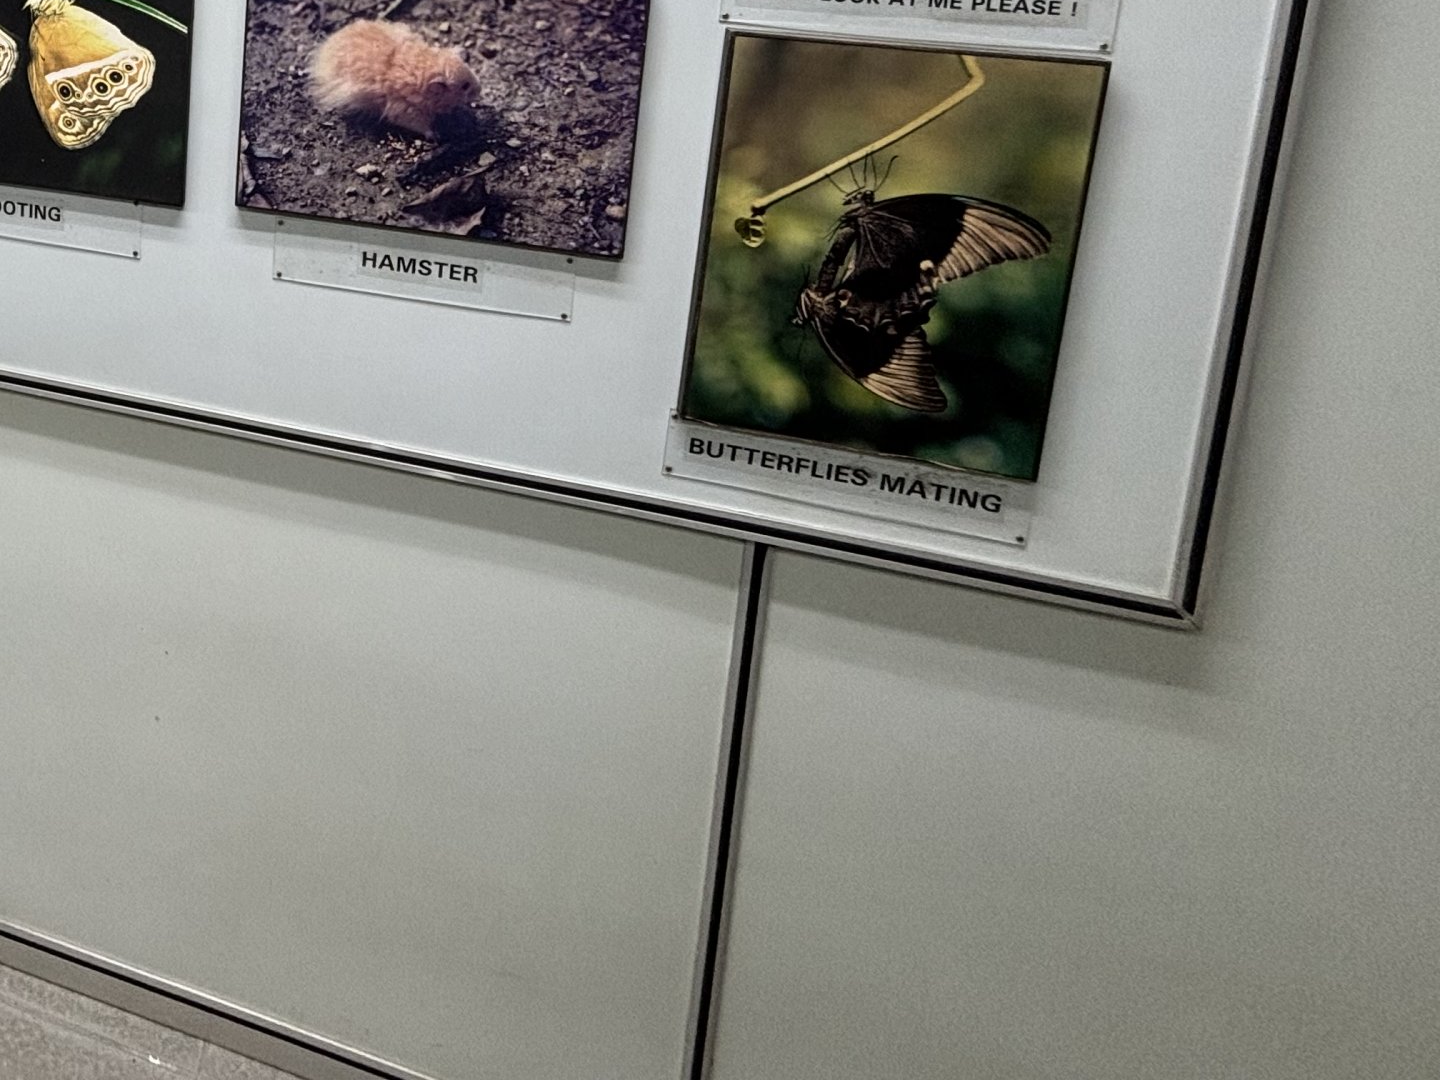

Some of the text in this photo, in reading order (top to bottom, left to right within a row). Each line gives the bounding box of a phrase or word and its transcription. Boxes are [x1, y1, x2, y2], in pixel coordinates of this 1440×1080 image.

[361, 251, 478, 283] HAMSTER
[688, 436, 1003, 513] BUTTERFLIES MATING
